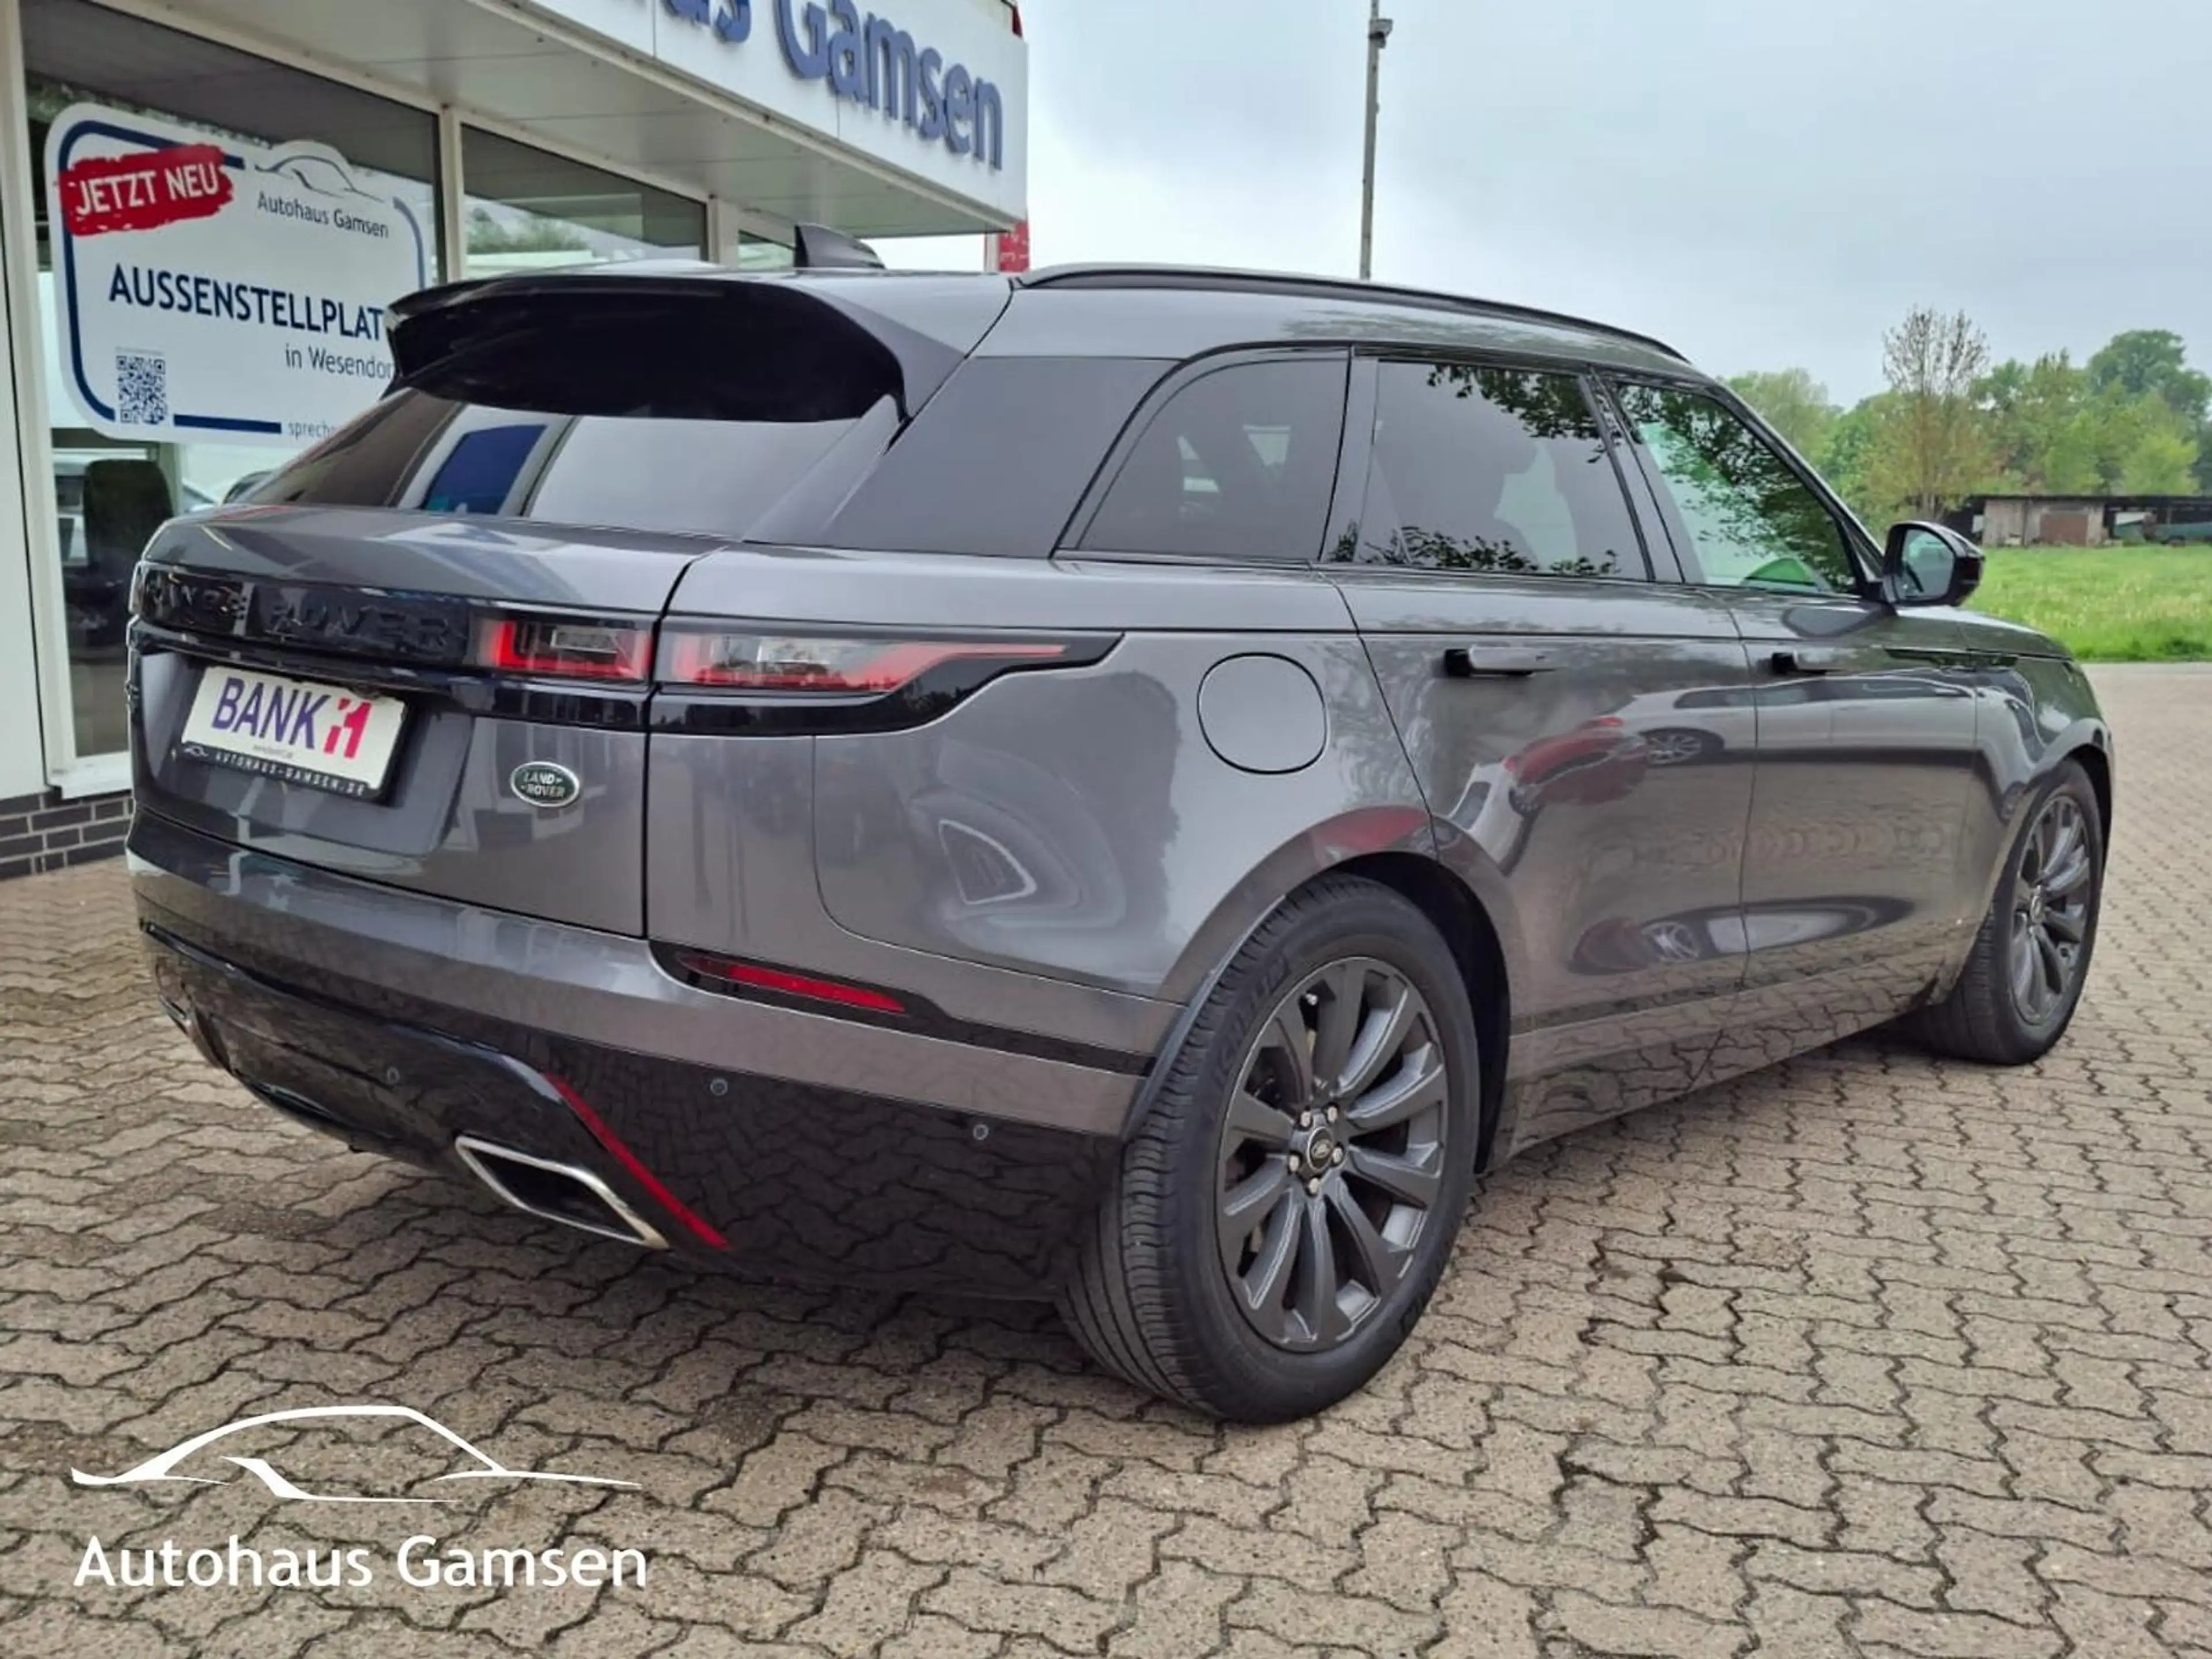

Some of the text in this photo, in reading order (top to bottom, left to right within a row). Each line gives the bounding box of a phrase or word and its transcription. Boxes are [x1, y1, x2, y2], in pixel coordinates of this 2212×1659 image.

[772, 0, 1003, 171] Gamsen
[75, 162, 219, 215] JETZT NEU
[257, 191, 389, 238] Autohaus Gamsen
[109, 263, 385, 341] AUSSENSTELLPLAT
[285, 343, 394, 379] in Wesendor
[288, 421, 337, 441] sprech
[523, 771, 556, 785] LAND
